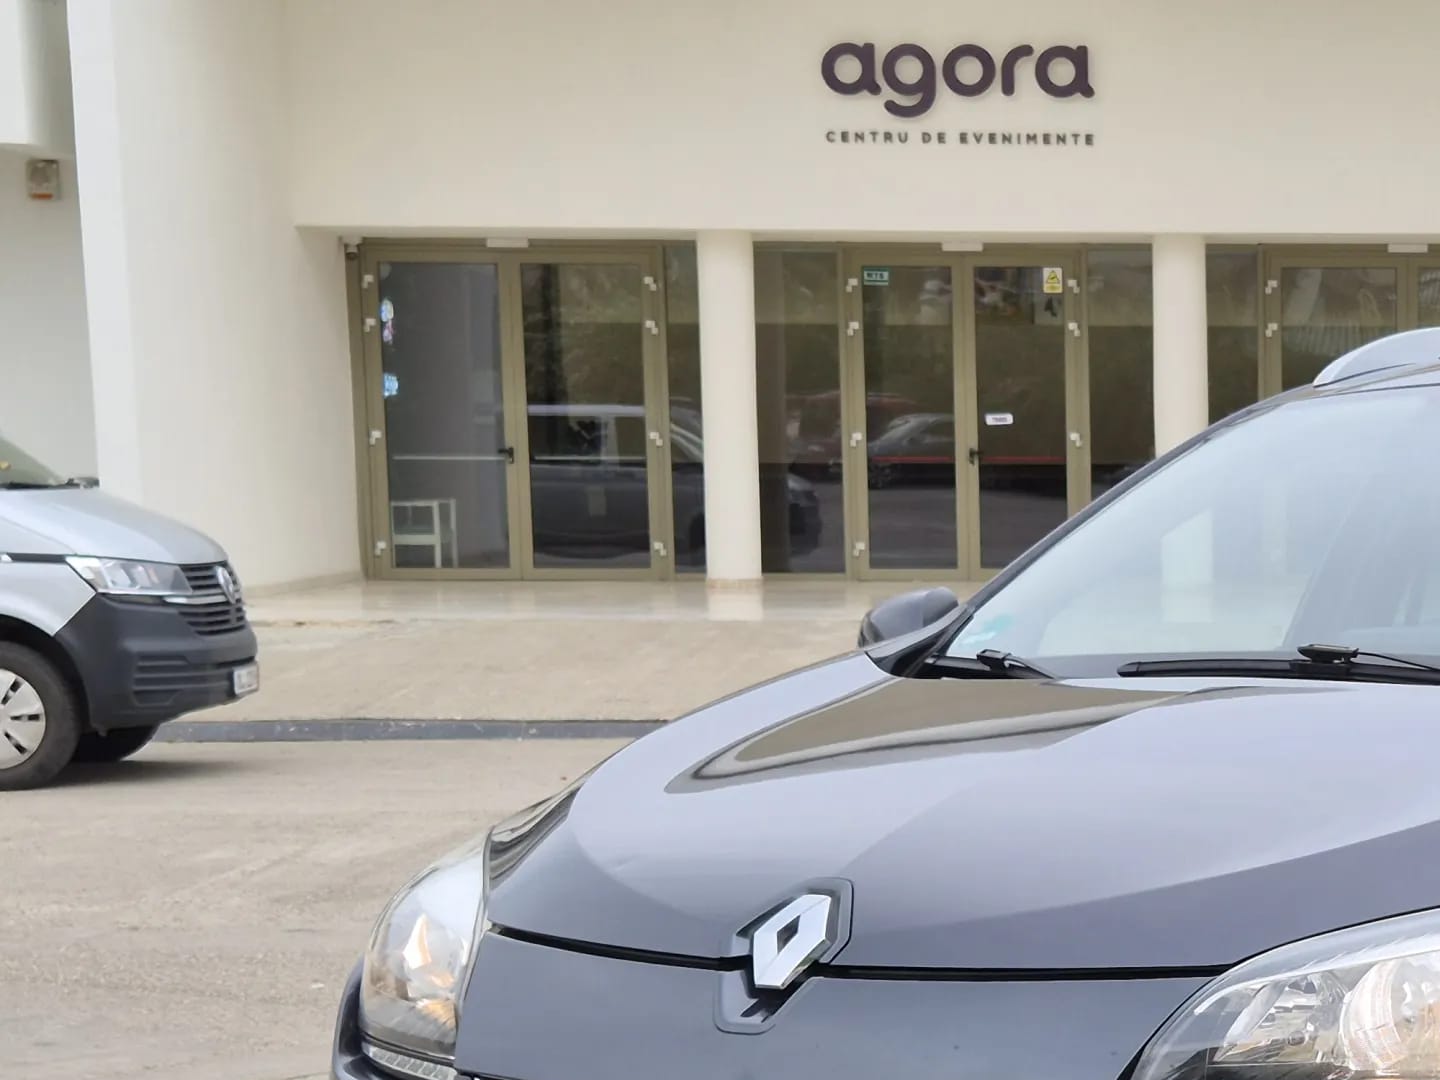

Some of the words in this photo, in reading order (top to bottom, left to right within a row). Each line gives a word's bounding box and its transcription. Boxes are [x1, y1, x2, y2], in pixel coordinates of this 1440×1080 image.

[821, 42, 1095, 118] agora
[825, 131, 909, 145] CENTRU
[921, 132, 947, 145] DE
[959, 132, 1095, 146] EVENIMENTE
